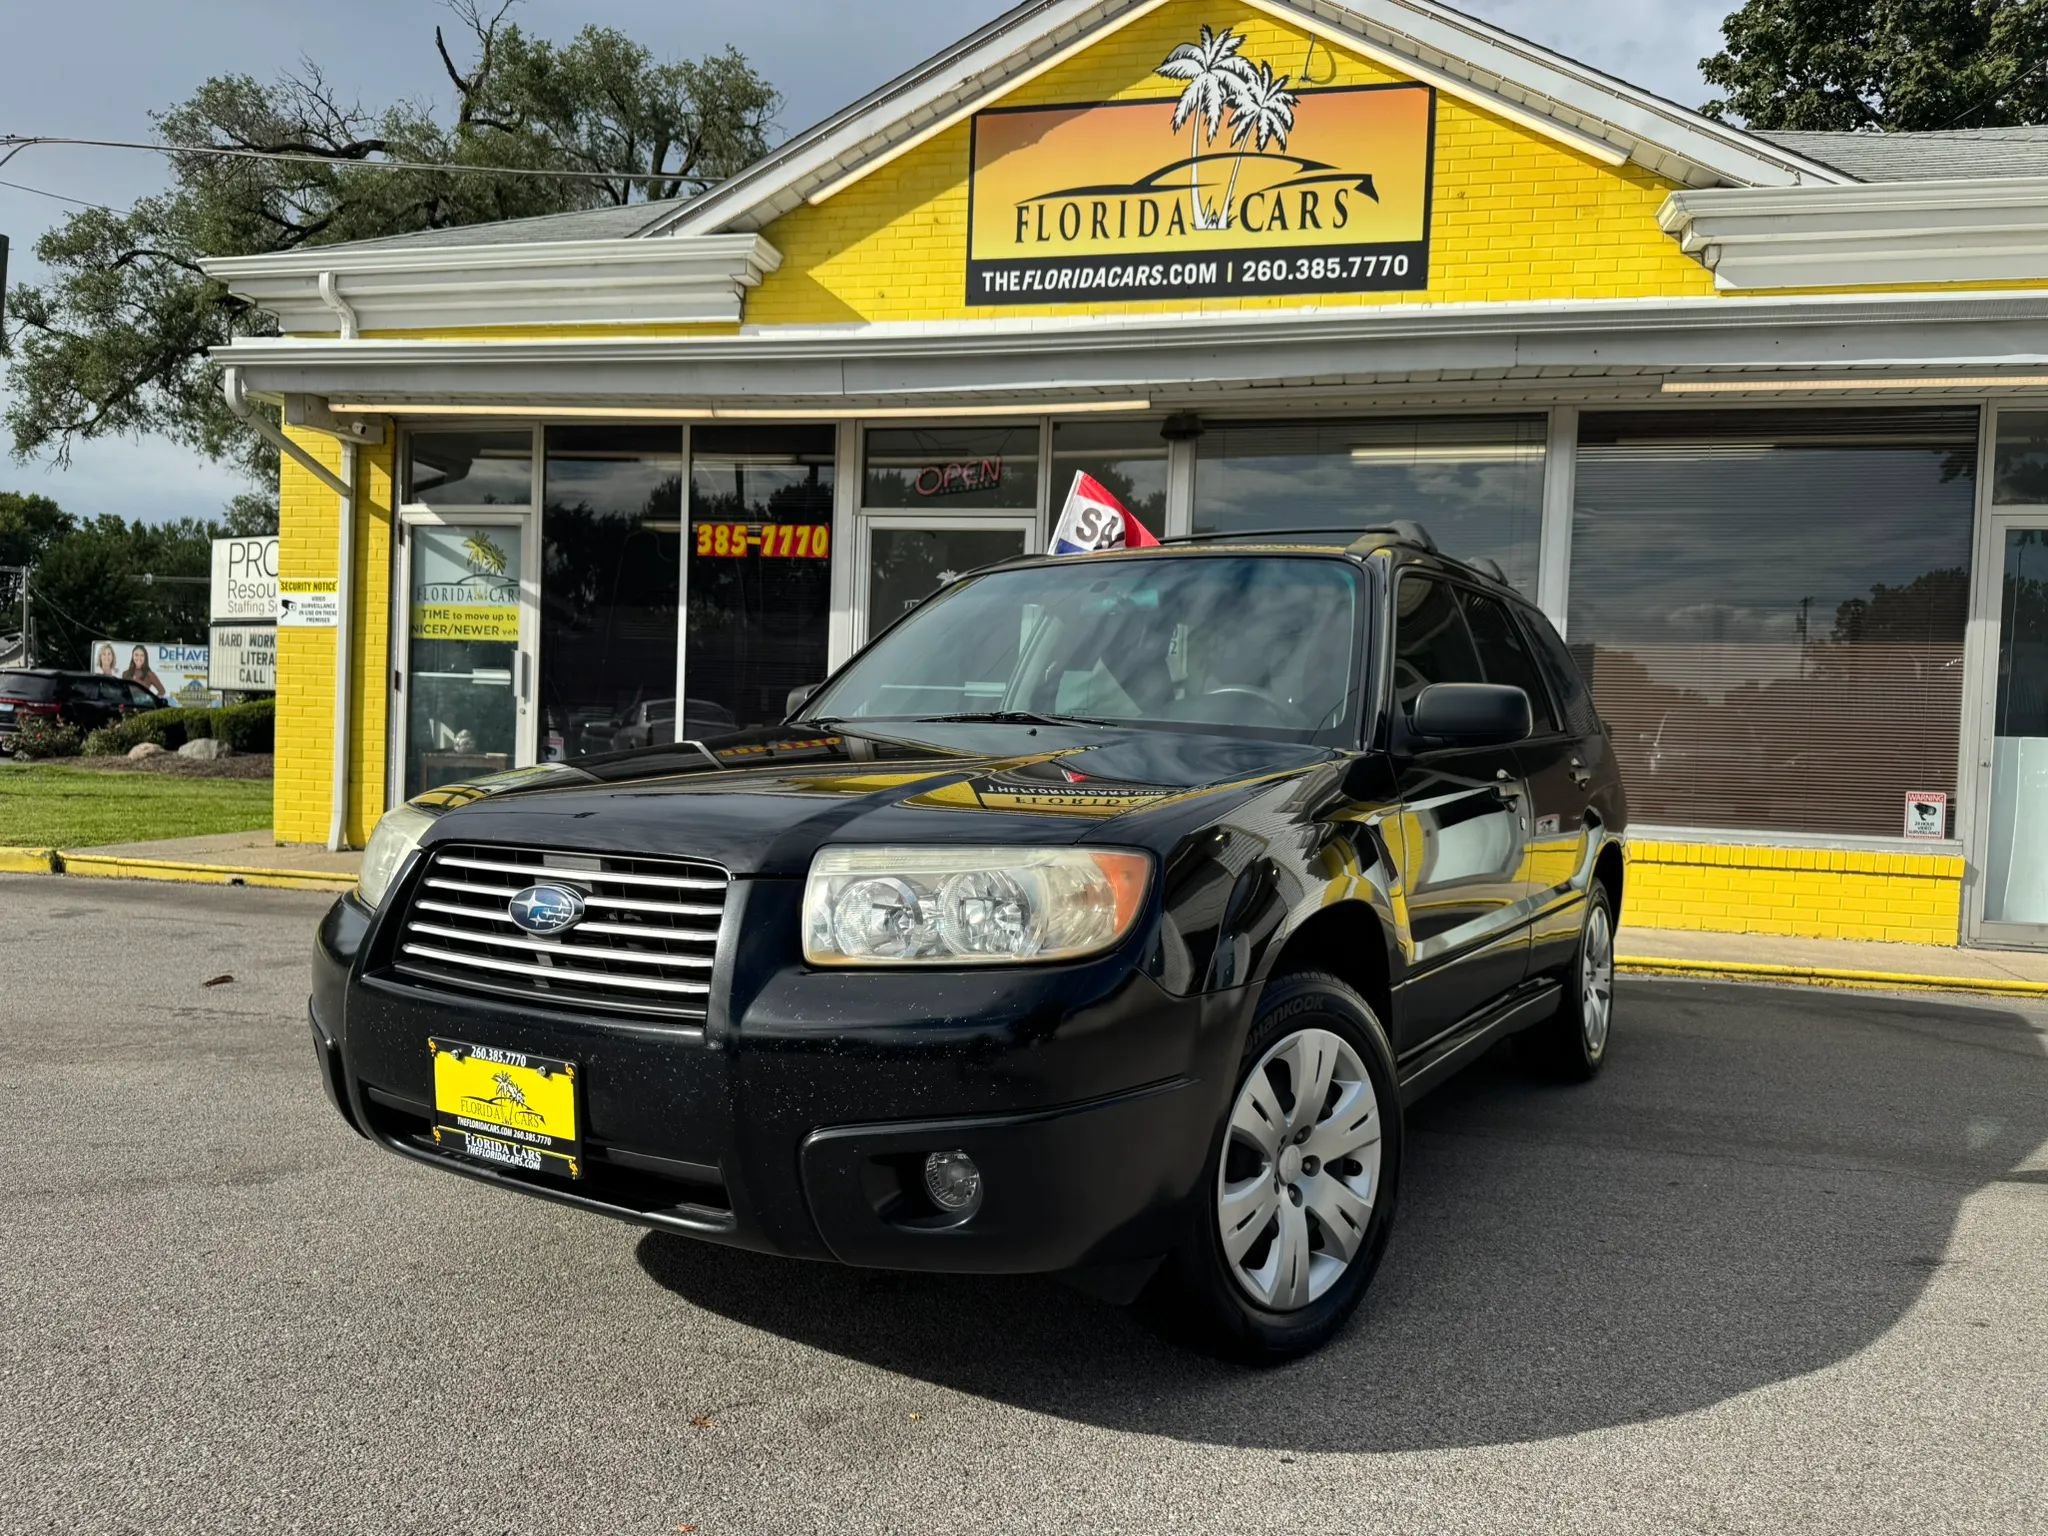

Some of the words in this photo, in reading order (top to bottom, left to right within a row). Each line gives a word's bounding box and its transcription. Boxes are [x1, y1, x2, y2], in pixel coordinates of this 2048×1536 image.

[1015, 196, 1187, 244] FLORIDA
[1239, 188, 1349, 233] CARS
[982, 262, 1217, 292] THEFLORIDACARS.COM
[1241, 254, 1409, 283] 260.385.7770
[915, 456, 1001, 496] OPEN
[697, 524, 830, 558] 385-7770
[280, 581, 311, 592] SECURITY
[313, 580, 337, 592] NOTICE
[417, 587, 473, 603] FLORIDA
[228, 600, 264, 615] Staffing
[422, 609, 450, 619] TIME
[453, 612, 462, 620] to
[465, 613, 489, 621] move
[493, 613, 503, 623] up
[507, 612, 516, 621] to
[219, 633, 242, 647] HARD
[412, 623, 499, 636] NICER/NEWER
[239, 668, 265, 683] CALL
[1908, 793, 1944, 802] WARNING
[471, 1046, 527, 1067] 260.385.7770
[460, 1099, 500, 1120] FLORIDA
[514, 1111, 540, 1128] CARS
[457, 1117, 513, 1138] THEFLORIDACARS.COM
[513, 1129, 552, 1146] 260.385.7770
[464, 1132, 509, 1153] FLORIDA
[512, 1143, 542, 1162] CARS
[466, 1145, 541, 1170] THEFLORIDACARS.COM
